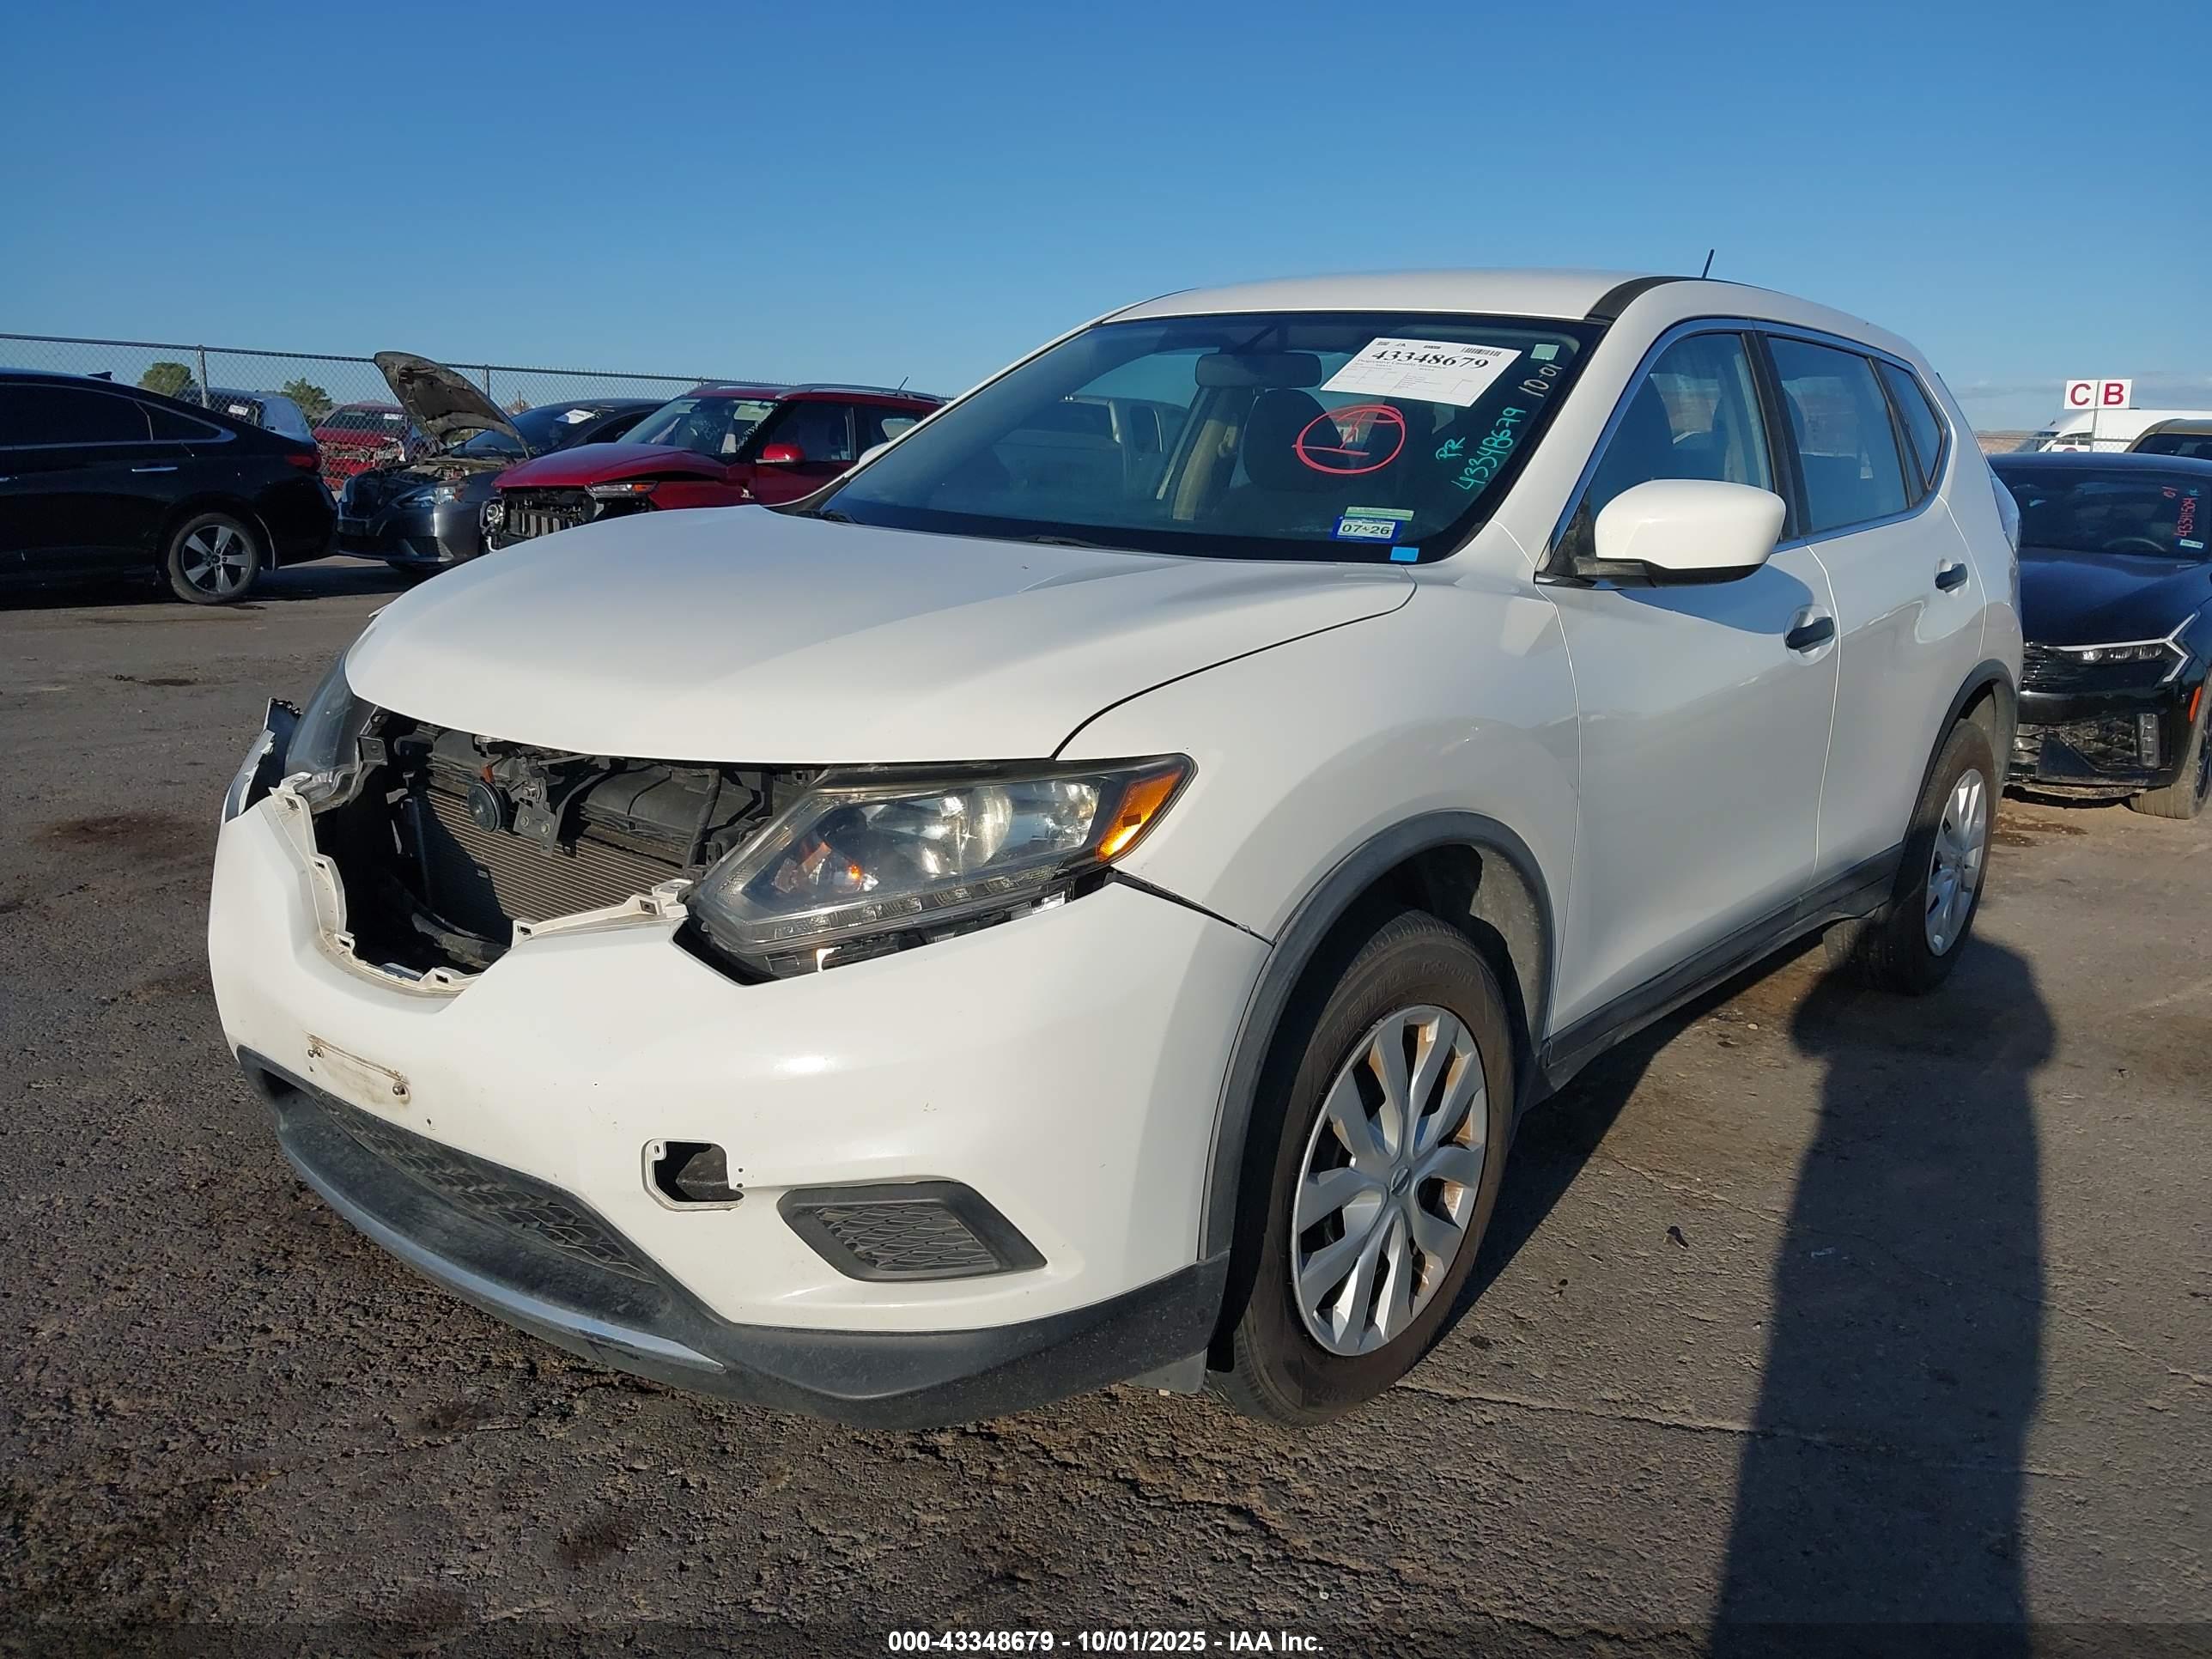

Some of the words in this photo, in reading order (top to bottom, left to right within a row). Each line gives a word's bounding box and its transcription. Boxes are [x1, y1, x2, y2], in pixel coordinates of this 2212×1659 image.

[1371, 349, 1490, 369] 43348679
[2070, 383, 2091, 405] C
[2104, 383, 2124, 405] B
[1451, 406, 1527, 490] 43348679
